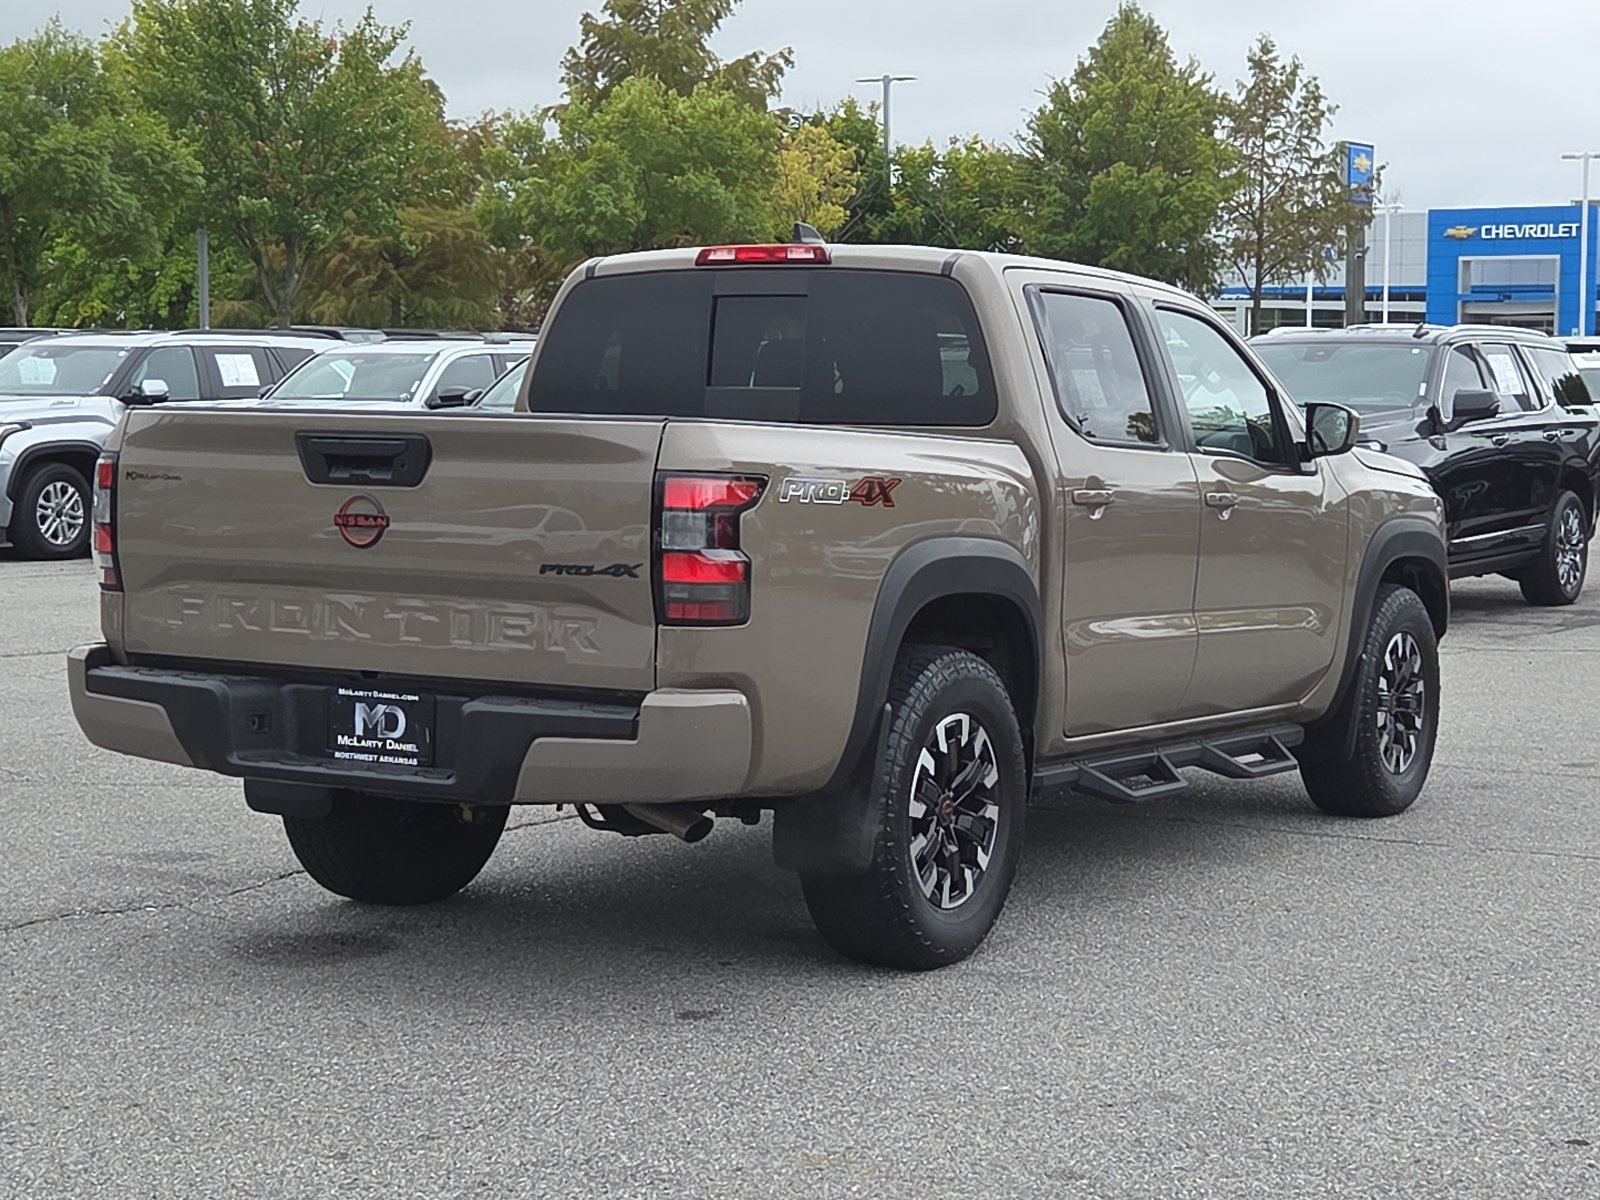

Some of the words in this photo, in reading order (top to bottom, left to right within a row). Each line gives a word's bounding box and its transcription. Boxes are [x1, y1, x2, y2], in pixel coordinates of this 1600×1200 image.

[1481, 223, 1580, 239] CHEVROLET
[335, 516, 387, 526] NISSAN
[164, 593, 602, 654] FRONTIER
[354, 702, 407, 739] MD
[334, 751, 379, 762] NORTHWEST
[379, 755, 418, 766] ARKANSAS
